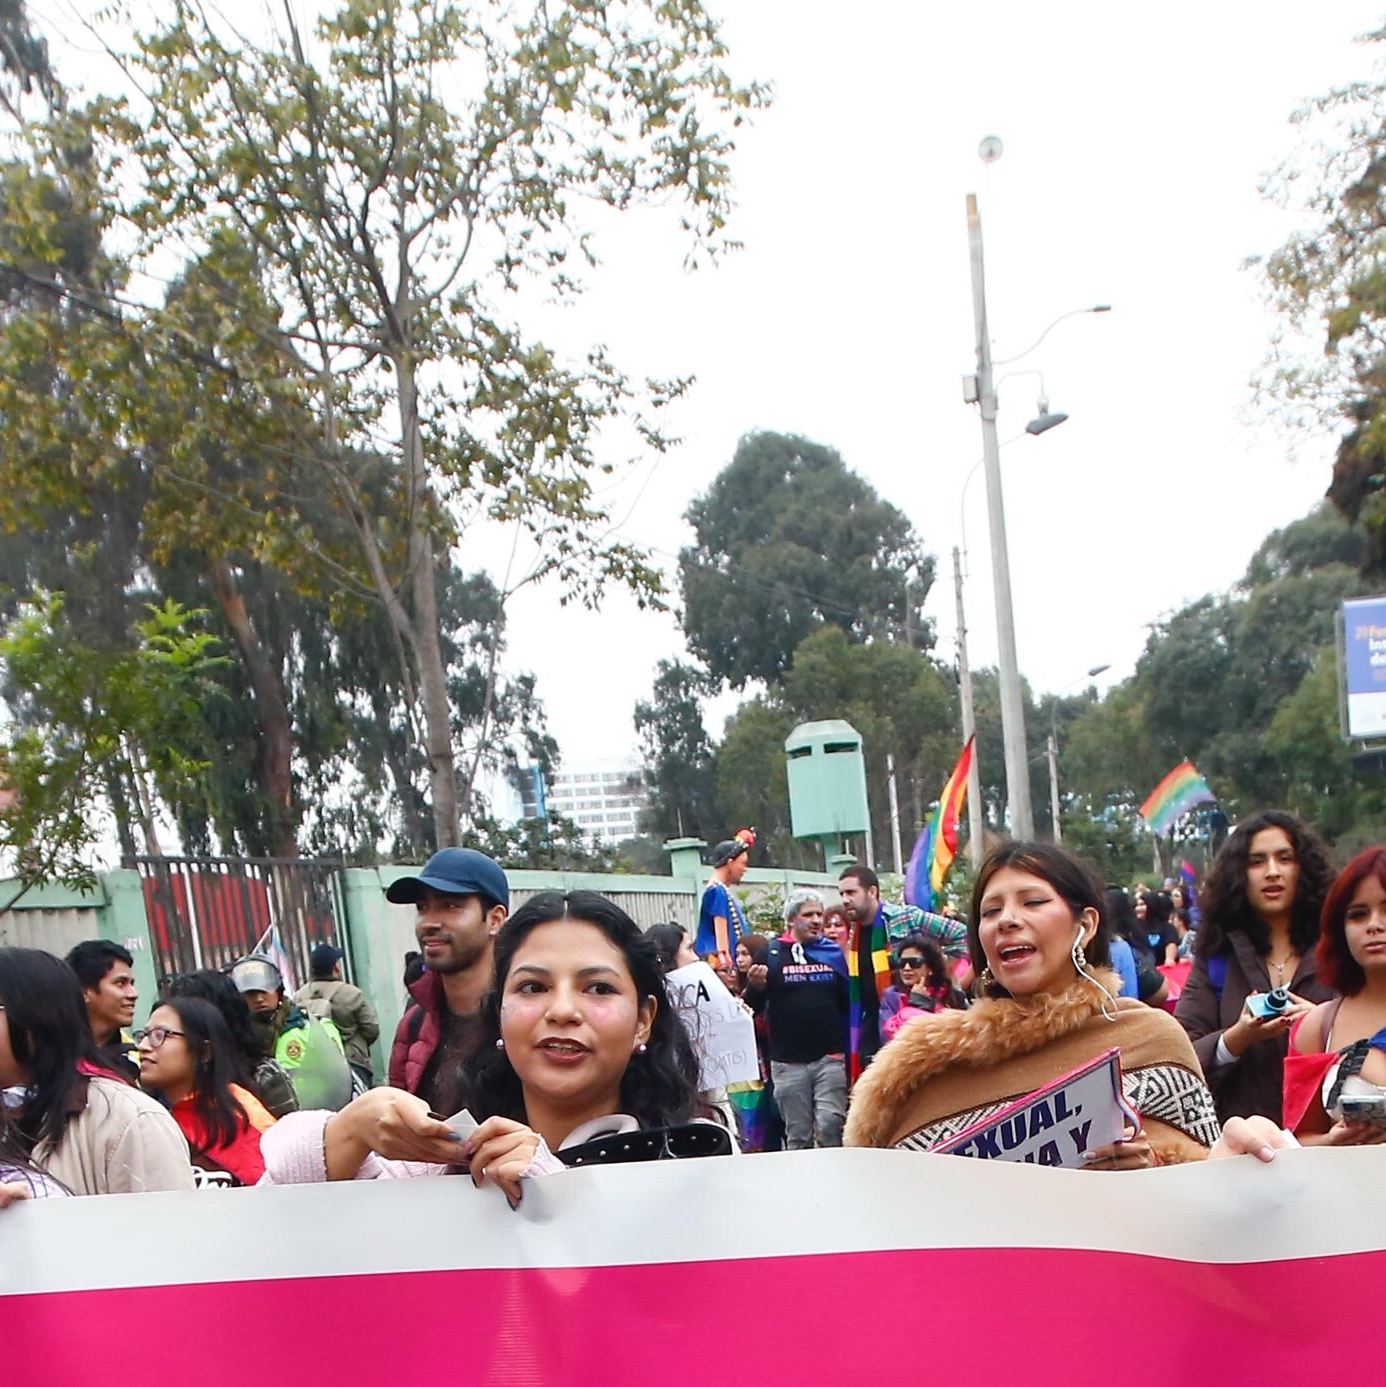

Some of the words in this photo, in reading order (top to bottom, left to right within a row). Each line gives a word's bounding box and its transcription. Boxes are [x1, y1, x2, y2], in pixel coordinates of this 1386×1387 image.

[784, 973, 806, 982] MEN
[954, 1090, 1082, 1159] EXUAL,
[1069, 1120, 1092, 1154] Y
